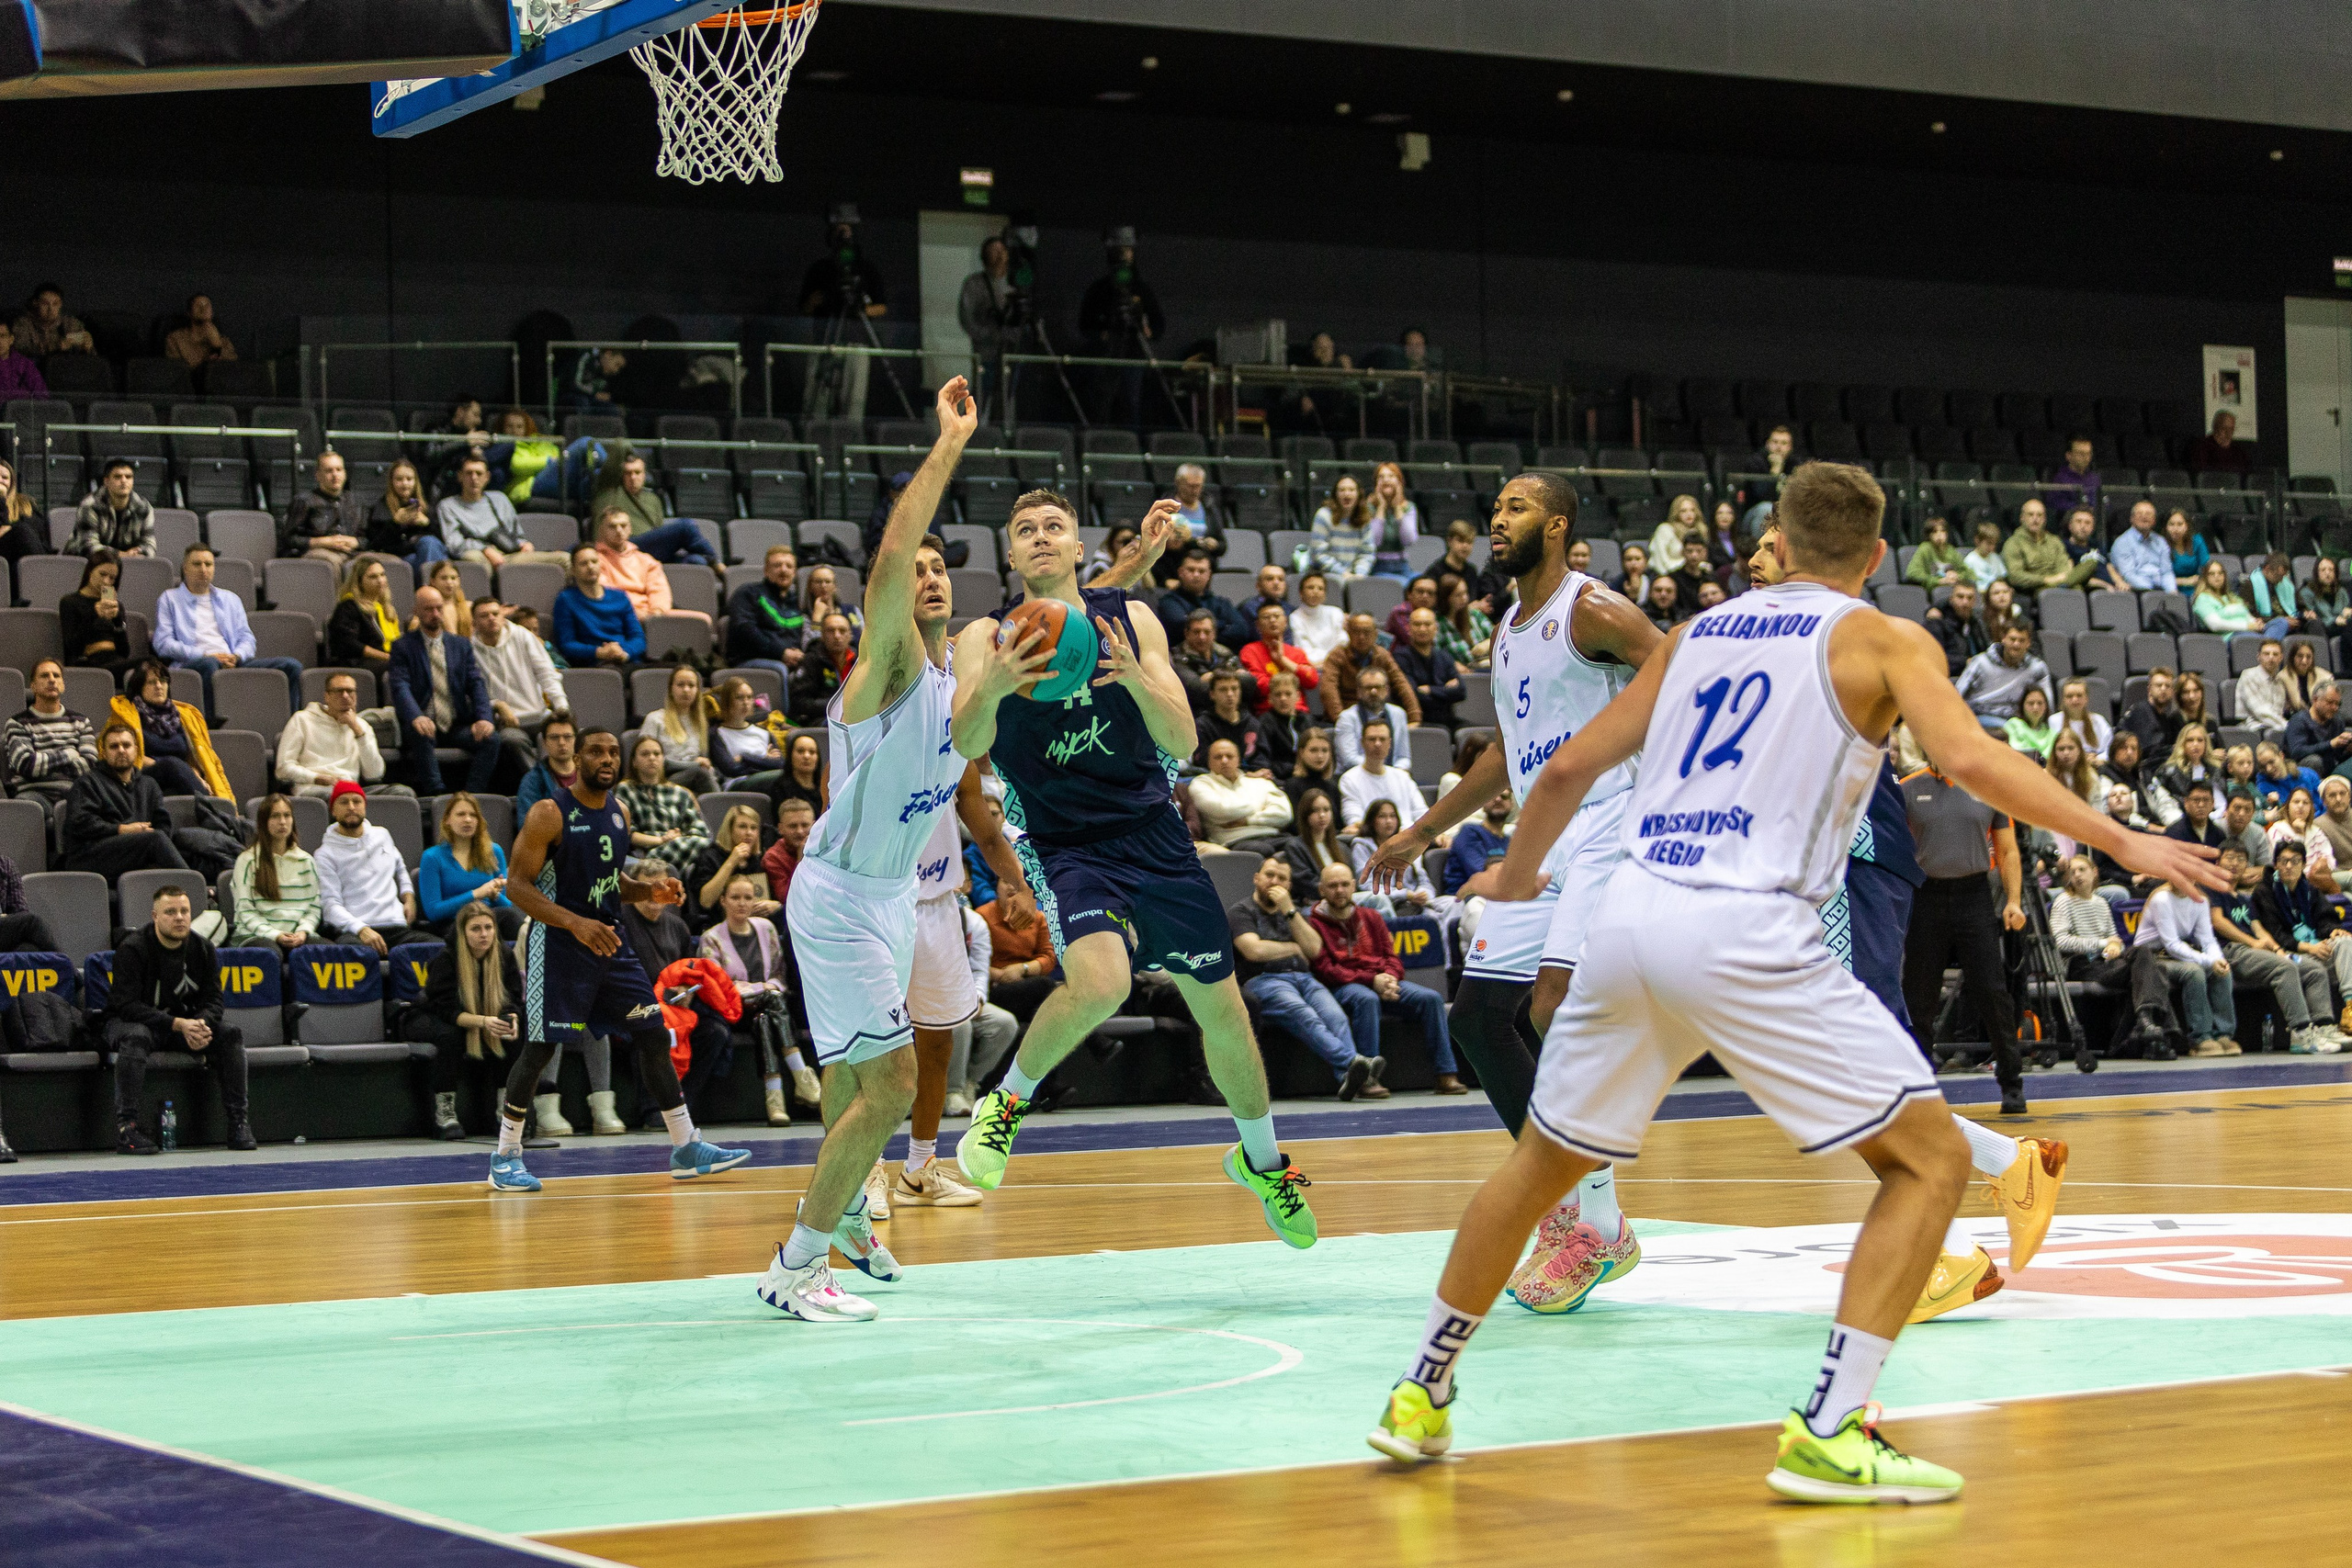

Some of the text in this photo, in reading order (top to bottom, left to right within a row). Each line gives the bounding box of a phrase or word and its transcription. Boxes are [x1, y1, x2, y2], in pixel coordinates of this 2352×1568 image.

[1690, 613, 1822, 639] BELIANKOU
[1516, 675, 1532, 719] 5
[1679, 670, 1771, 779] 12
[598, 834, 614, 862] 3
[1643, 839, 1707, 866] REGIO
[1068, 908, 1103, 923] Kempa
[1389, 929, 1430, 954] VIP
[1, 968, 59, 998] VIP
[311, 962, 367, 990] VIP
